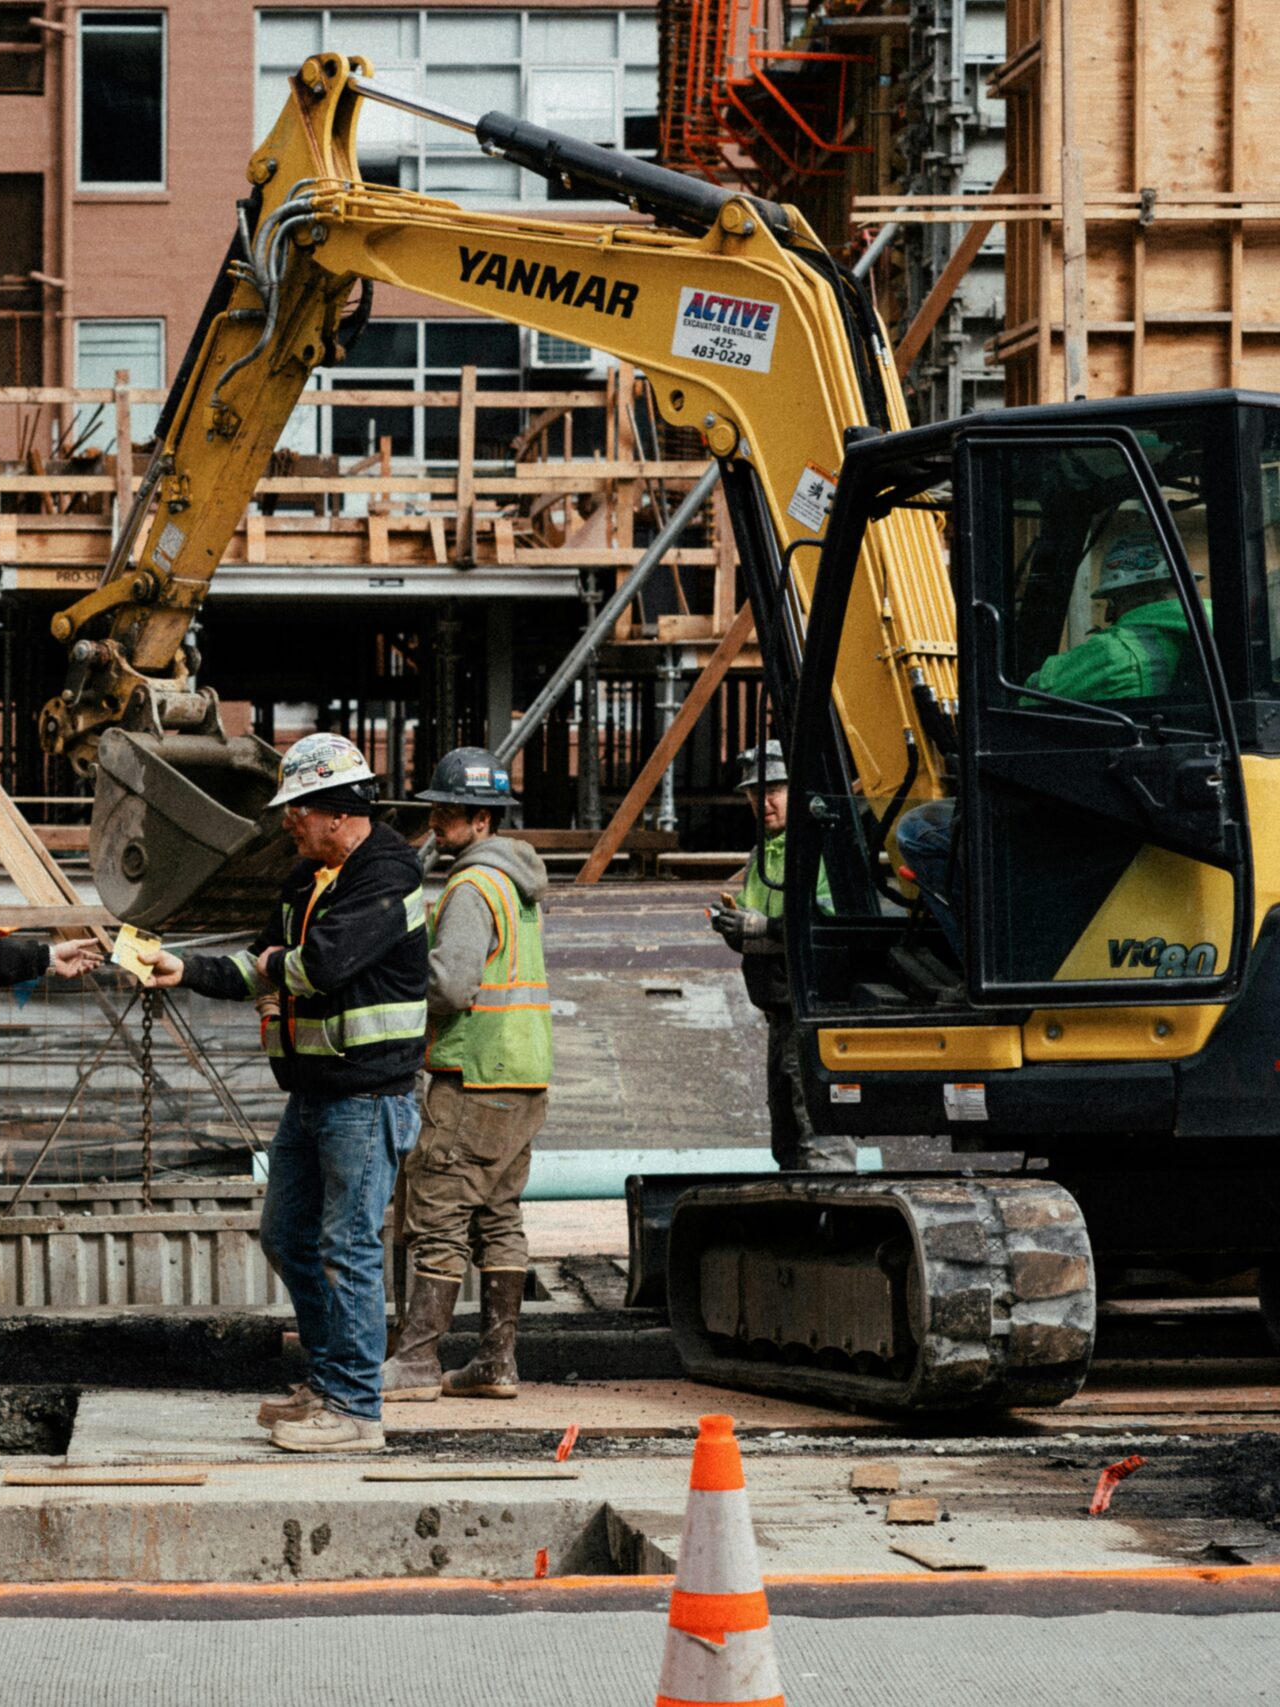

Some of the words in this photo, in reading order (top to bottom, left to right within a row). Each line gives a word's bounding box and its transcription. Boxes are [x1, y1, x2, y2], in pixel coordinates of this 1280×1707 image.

[459, 246, 639, 319] YANMAR
[683, 292, 774, 332] ACTIVE
[682, 318, 721, 332] EXCAVATOR
[691, 344, 752, 367] 483-0229
[56, 570, 103, 583] PRO-SH
